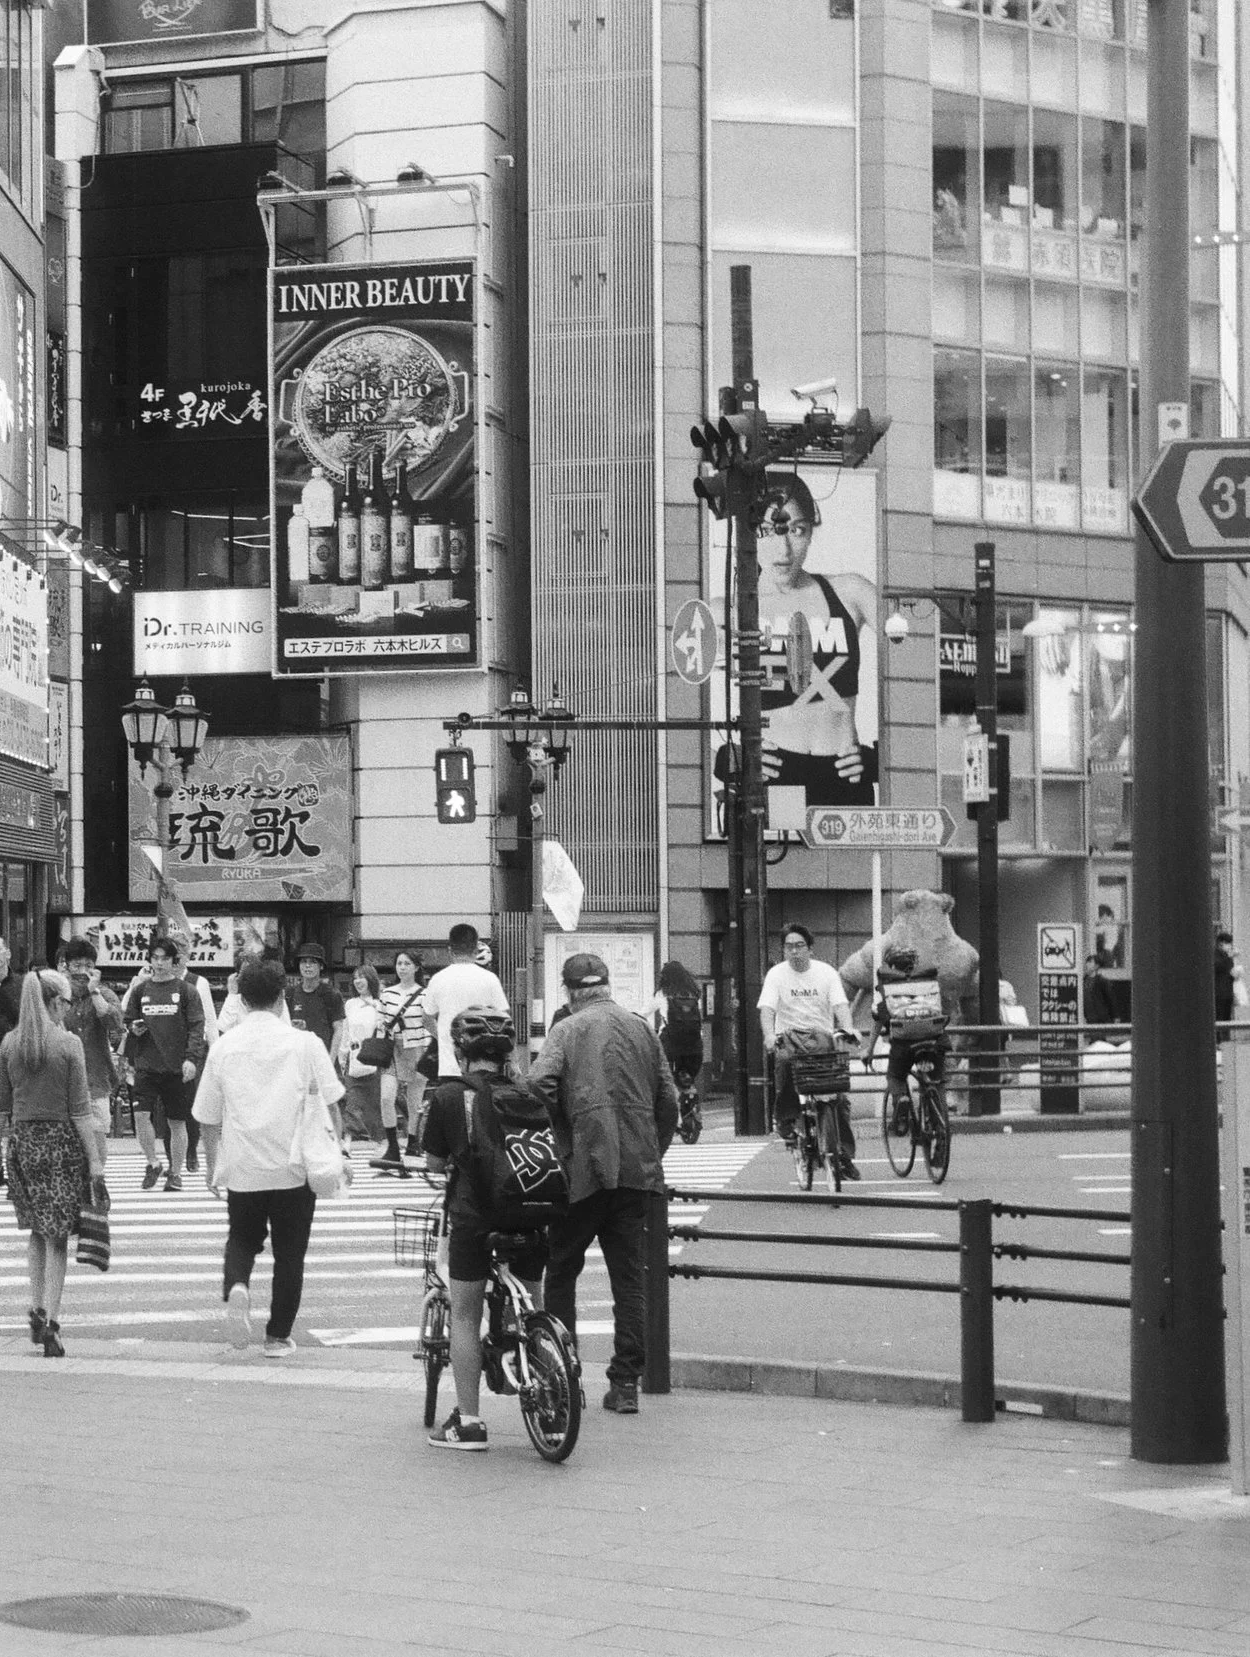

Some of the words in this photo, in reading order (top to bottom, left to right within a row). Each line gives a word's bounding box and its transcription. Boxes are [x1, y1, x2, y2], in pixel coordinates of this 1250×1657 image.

[278, 281, 362, 312] INNER
[366, 274, 471, 307] BEAUTY
[140, 383, 165, 402] 4F
[200, 381, 251, 394] kurojoka
[323, 379, 389, 401] Esthe
[393, 377, 432, 399] Pro
[289, 639, 366, 654] エステプロラボ
[373, 637, 442, 653] 六本木ヒルズ
[178, 783, 302, 801] 沖縄ダイニング
[821, 820, 844, 835] 319
[850, 813, 937, 829] 外苑東通り
[168, 802, 321, 864] 琉歌
[221, 867, 262, 879] RYUKA
[790, 989, 819, 997] MoMA
